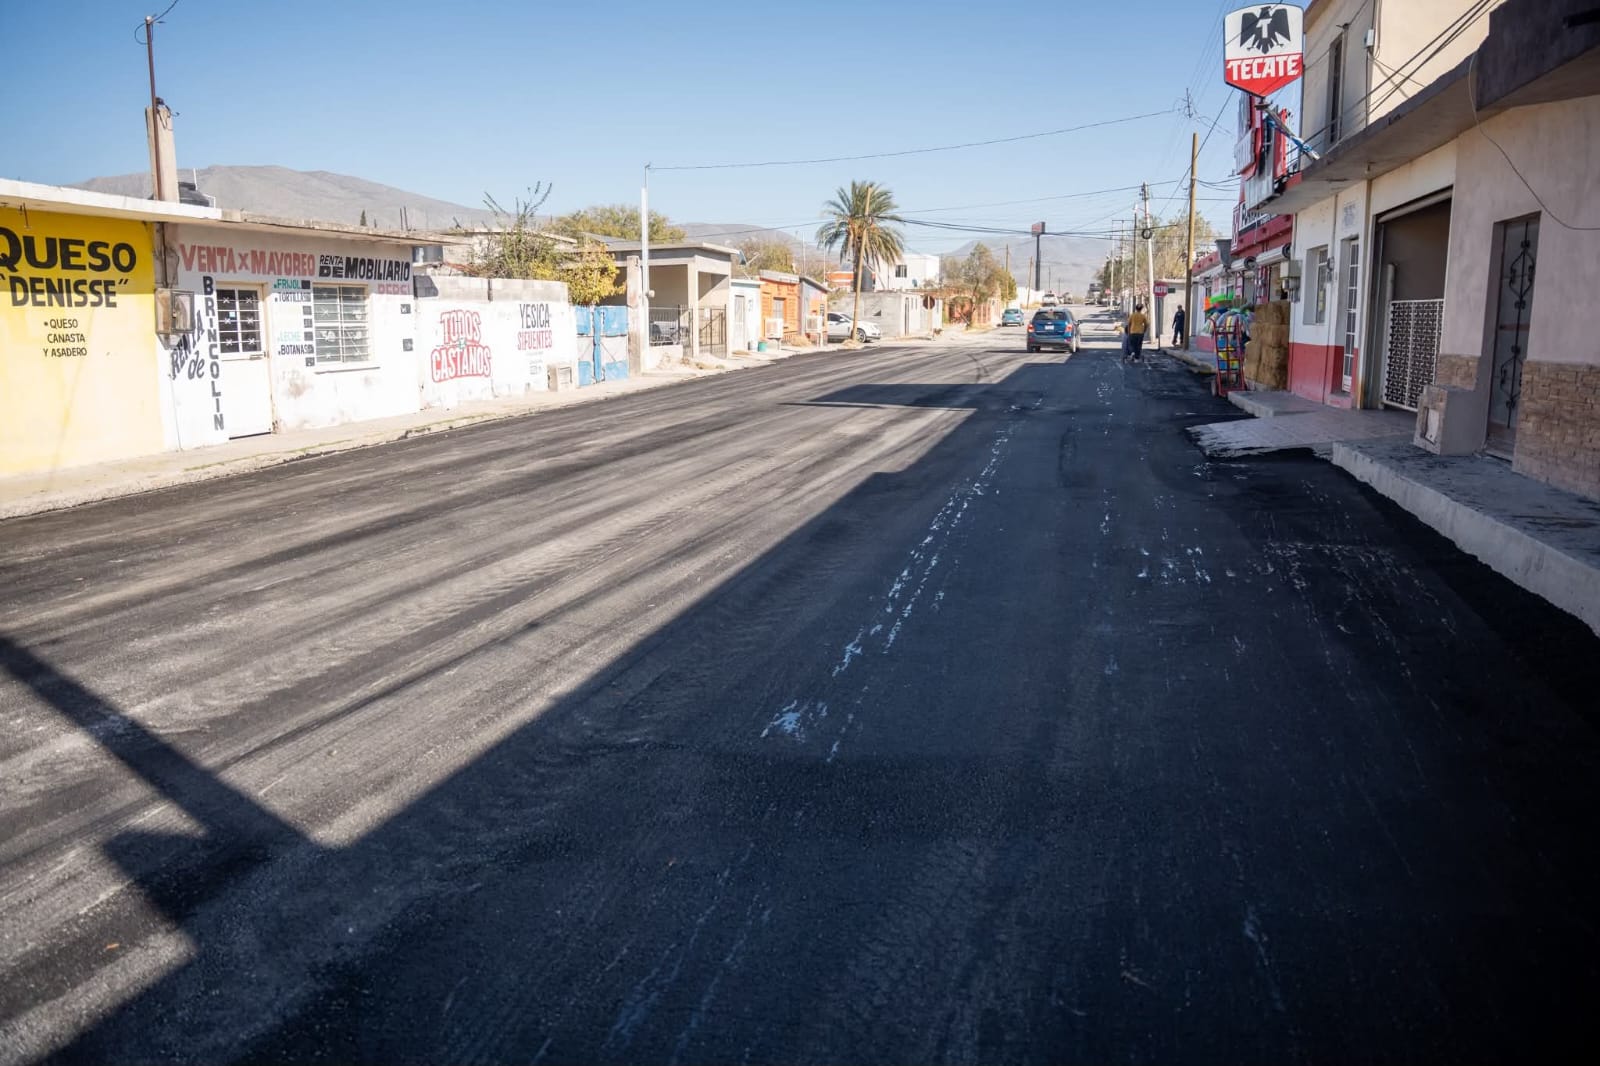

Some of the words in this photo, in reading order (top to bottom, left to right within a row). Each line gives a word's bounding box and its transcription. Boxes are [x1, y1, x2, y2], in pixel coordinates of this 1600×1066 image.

[1256, 18, 1271, 39] T
[1226, 54, 1300, 81] TECATE
[179, 244, 237, 274] VENTA
[250, 248, 316, 277] MAYOREO
[319, 254, 344, 266] RENTA
[319, 265, 344, 279] DE
[344, 256, 411, 281] MOBILIARIO
[277, 278, 301, 290] FRIJOL
[49, 318, 78, 329] QUESO
[519, 303, 550, 329] YESICA
[441, 310, 481, 345] TODOS
[47, 333, 86, 344] CANASTA
[517, 330, 552, 351] SIFUENTES
[43, 348, 49, 358] Y
[51, 347, 87, 358] ASADERO
[187, 349, 205, 381] de
